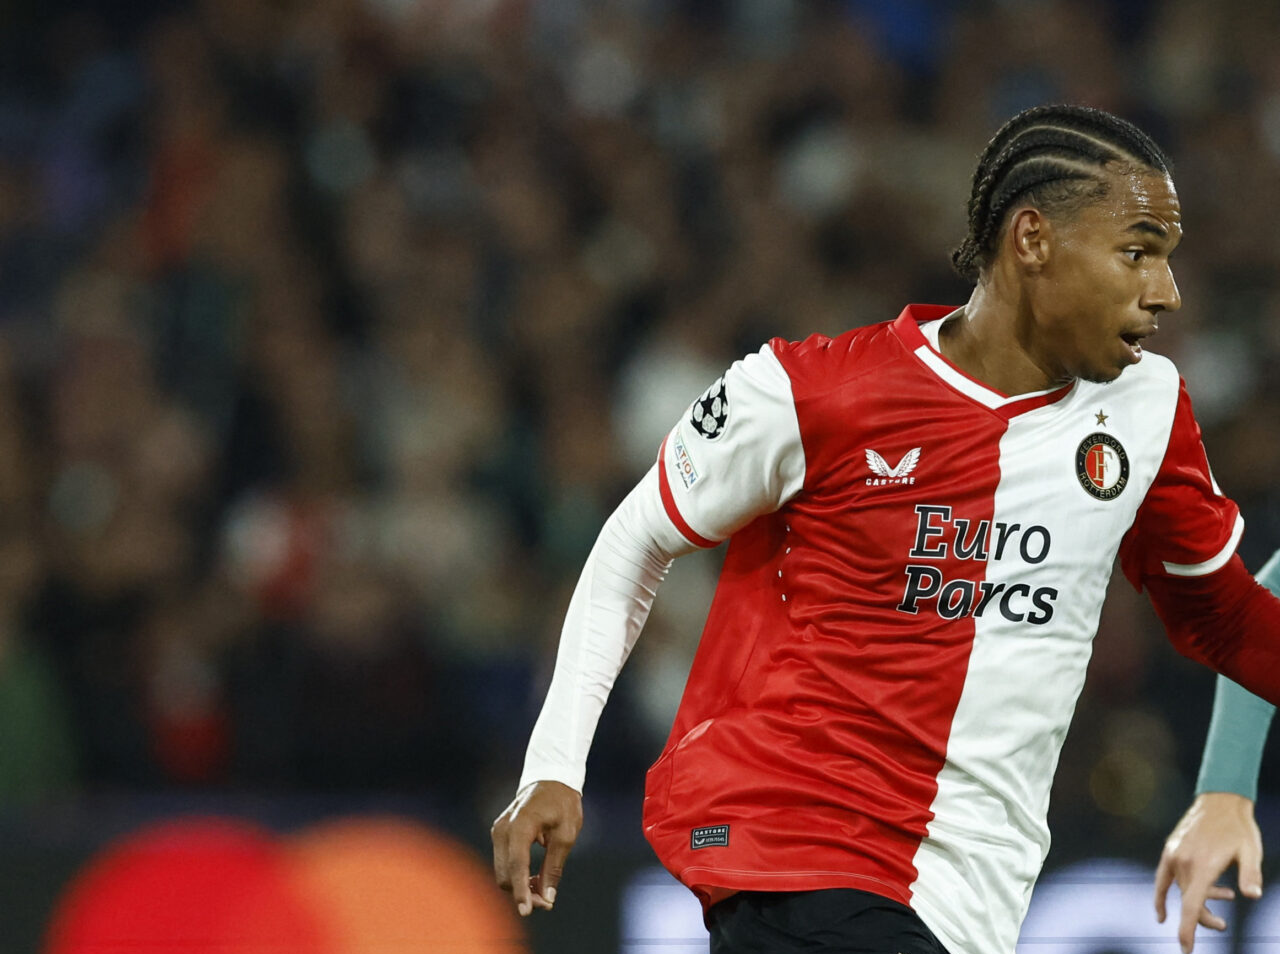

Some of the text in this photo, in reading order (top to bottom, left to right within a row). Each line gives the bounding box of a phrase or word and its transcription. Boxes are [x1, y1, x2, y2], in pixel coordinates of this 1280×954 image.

[1080, 472, 1126, 498] ROTTERDAM
[909, 504, 1051, 564] Euro
[896, 565, 1058, 625] Parcs
[695, 828, 726, 836] CASTORE
